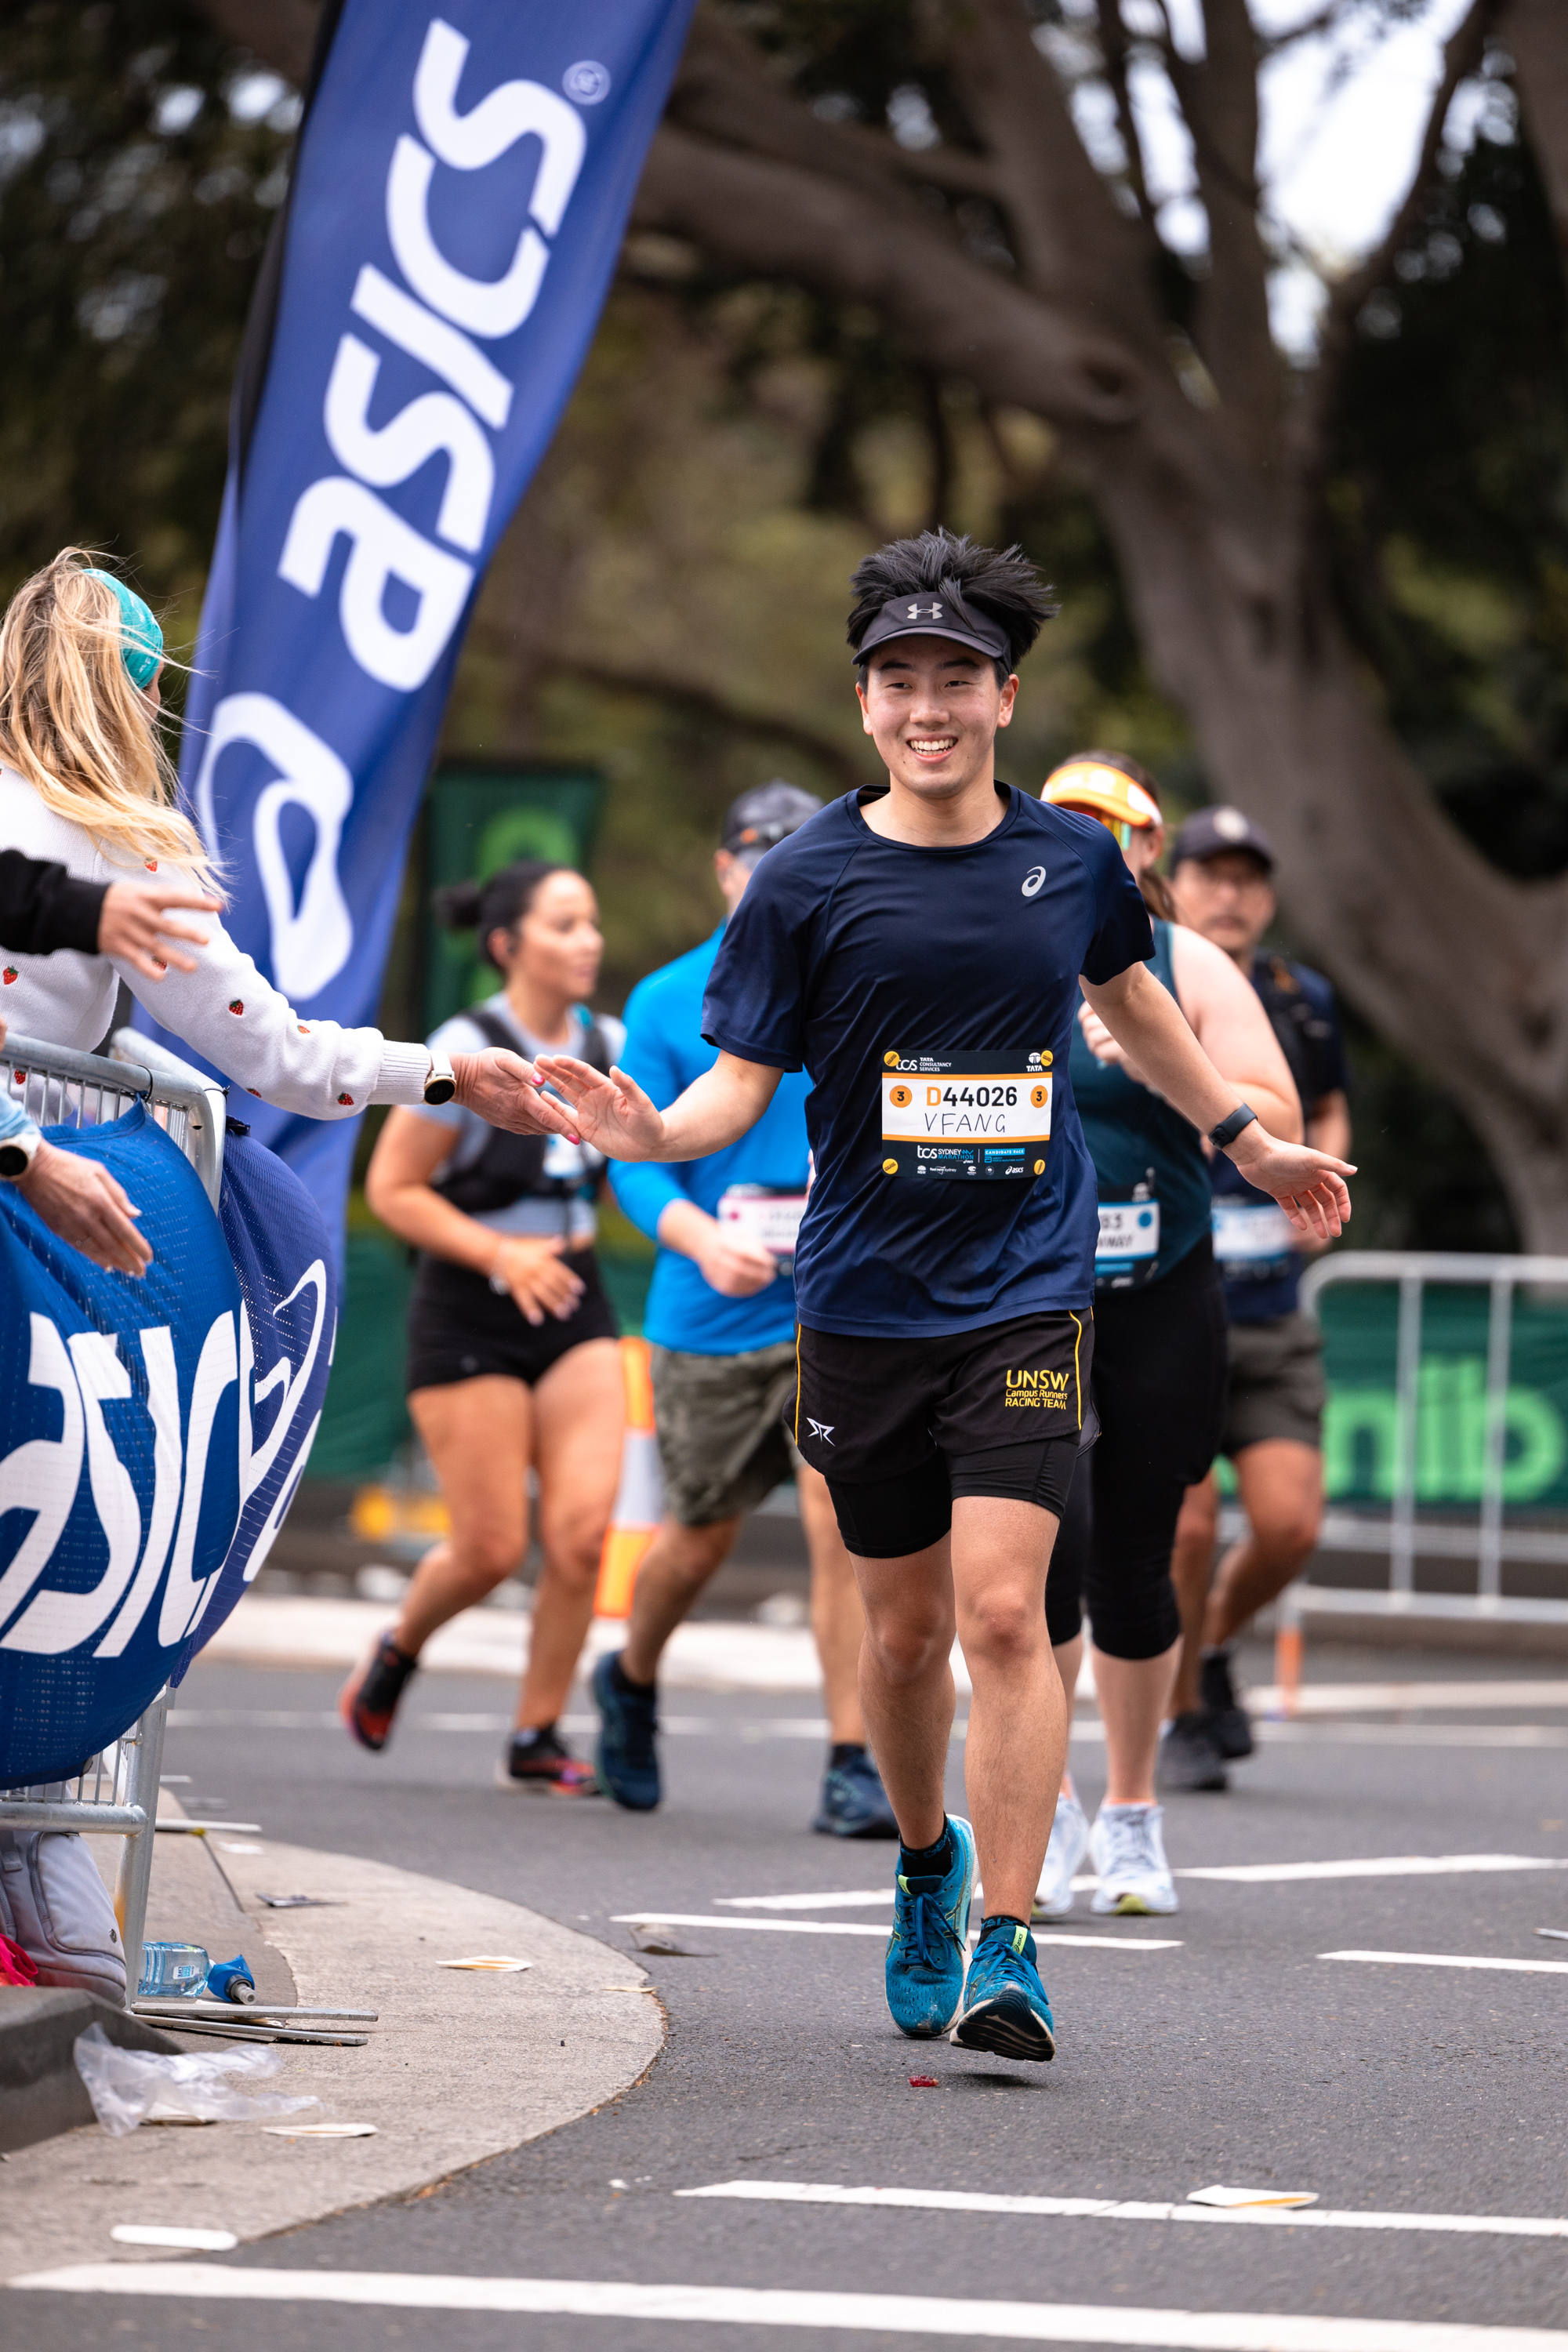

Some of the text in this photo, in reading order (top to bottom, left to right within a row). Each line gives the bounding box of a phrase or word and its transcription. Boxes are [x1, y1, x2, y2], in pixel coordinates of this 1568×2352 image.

[278, 18, 587, 692] asics
[897, 1086, 1043, 1107] 3 D44026 3
[917, 1145, 938, 1159] tcs
[1006, 1369, 1069, 1392] UNSW
[1005, 1388, 1068, 1400] Campus Runners
[1004, 1397, 1066, 1410] RACING TEAM
